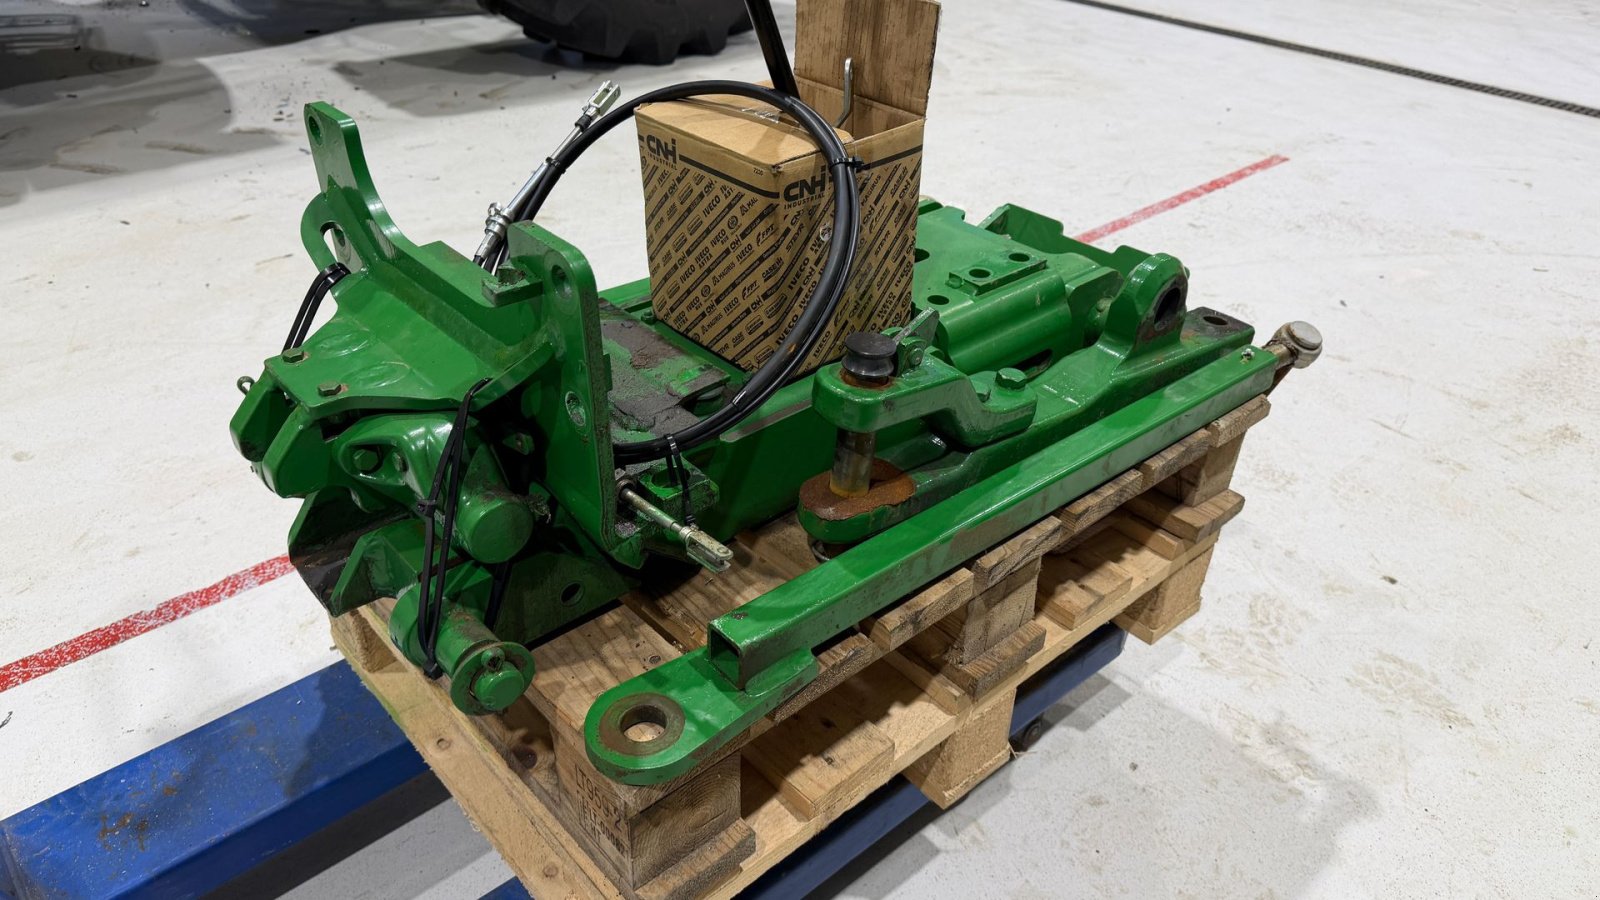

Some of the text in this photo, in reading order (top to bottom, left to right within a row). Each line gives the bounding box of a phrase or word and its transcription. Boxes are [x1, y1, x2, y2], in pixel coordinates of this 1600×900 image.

[784, 192, 825, 210] INDUSTRIAL
[861, 174, 881, 207] MAGIRUS
[702, 195, 721, 217] IVECO
[710, 228, 727, 247] IVECO
[786, 222, 804, 253] STEYR
[875, 230, 890, 257] STEYR
[694, 246, 710, 264] IVECO
[698, 253, 713, 269] ASTRA
[735, 243, 753, 262] IVECO
[679, 264, 696, 283] IVECO
[717, 261, 736, 281] MAGIRUS
[788, 257, 811, 290] IVECO
[895, 260, 911, 287] IVECO
[686, 296, 700, 311] IVECO
[723, 296, 739, 313] IVECO
[798, 280, 817, 309] IVECO
[877, 292, 893, 318] IVECO
[673, 311, 686, 325] IVECO
[776, 313, 799, 346] IVECO
[813, 330, 831, 357] IVECO
